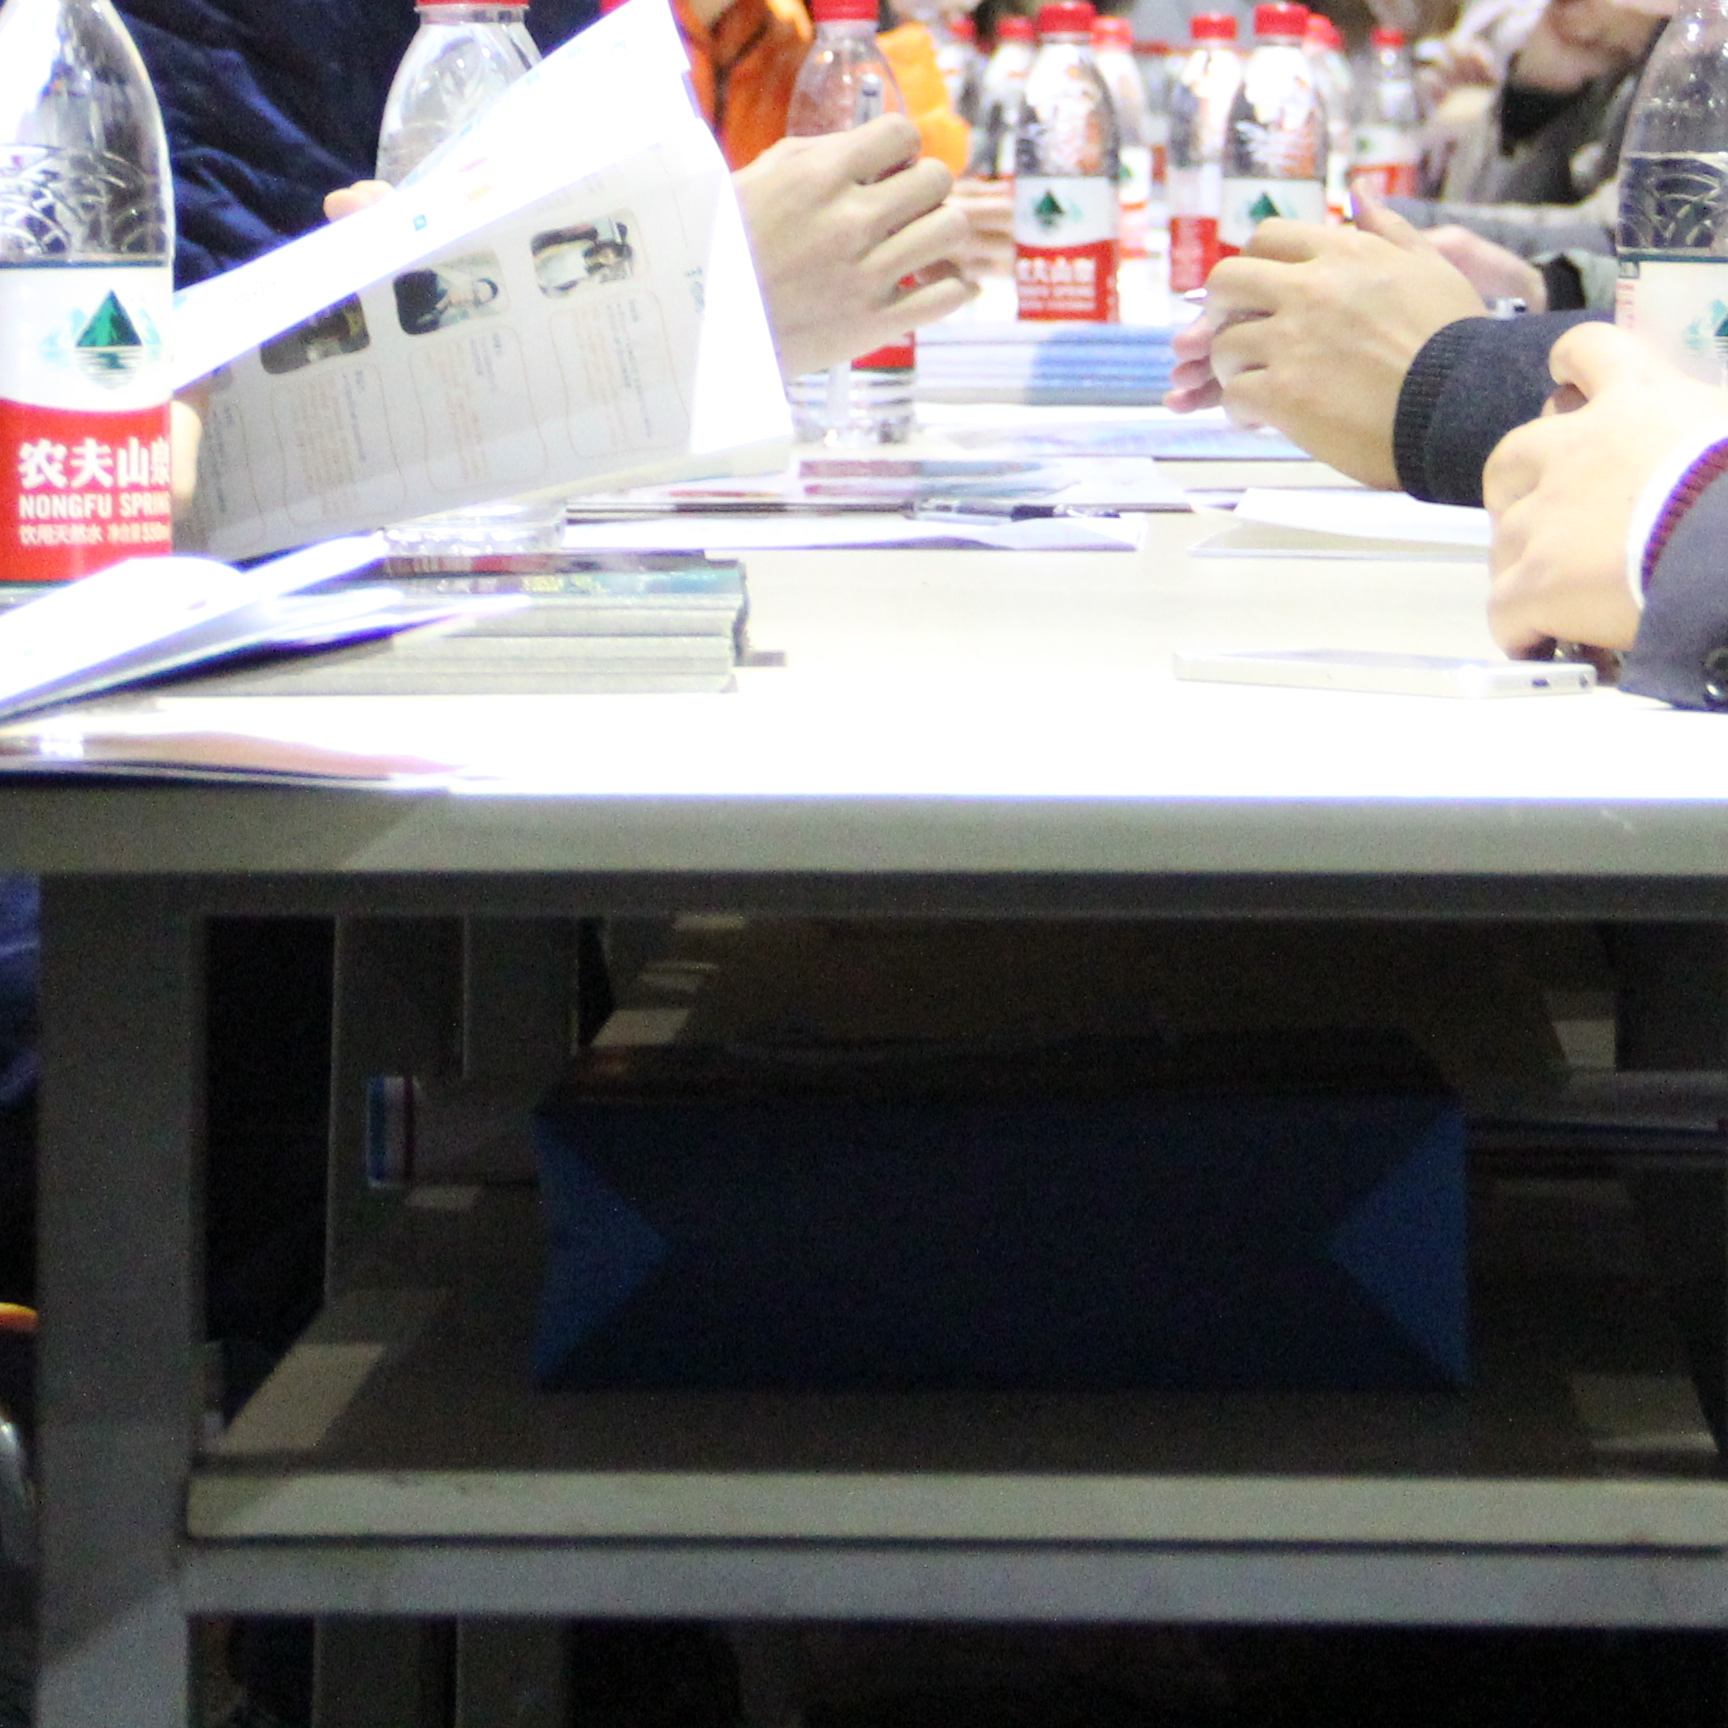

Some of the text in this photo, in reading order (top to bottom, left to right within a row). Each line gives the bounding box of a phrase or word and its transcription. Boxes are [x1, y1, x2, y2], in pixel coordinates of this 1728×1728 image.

[18, 436, 170, 489] 农夫山泉
[19, 492, 113, 520] NONGFU
